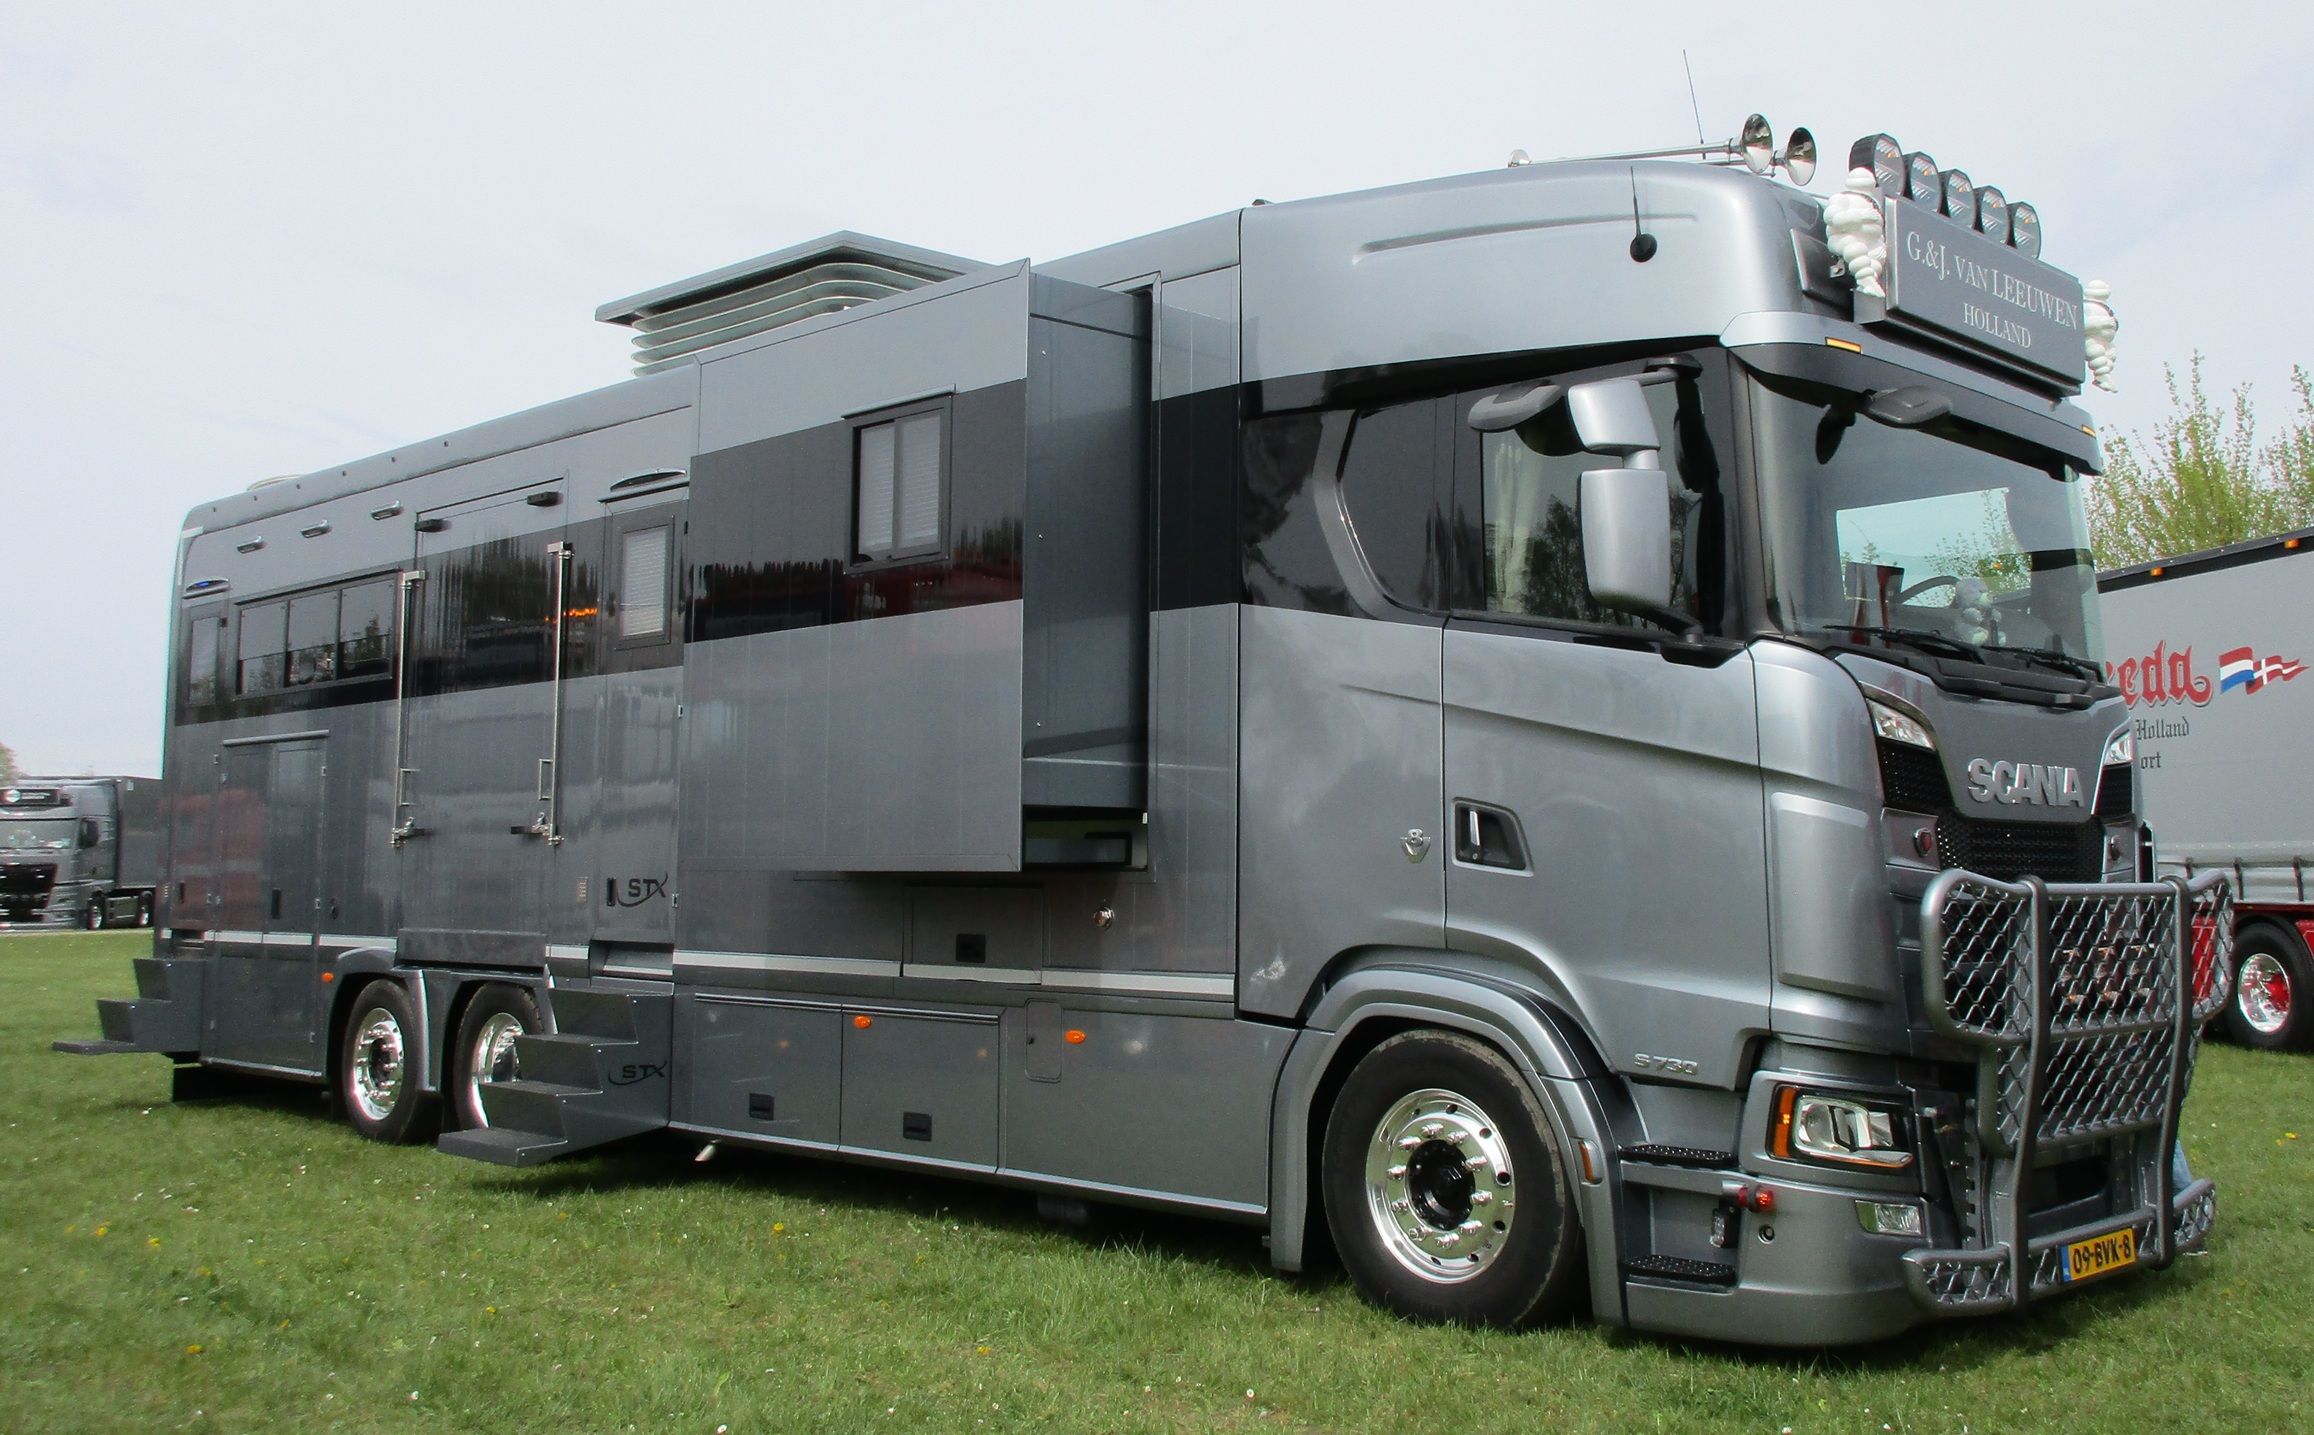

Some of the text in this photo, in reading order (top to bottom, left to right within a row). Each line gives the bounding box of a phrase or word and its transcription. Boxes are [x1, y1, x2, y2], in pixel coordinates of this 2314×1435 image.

[1907, 231, 2078, 331] G.&J. VAN LEEUWEN
[1963, 303, 2031, 349] HOLLAND
[2135, 715, 2190, 740] Holland
[1967, 758, 2085, 808] SCANIA
[626, 871, 669, 899] STX
[620, 1060, 668, 1080] STX
[2072, 1234, 2132, 1275] 09-BVK-8
